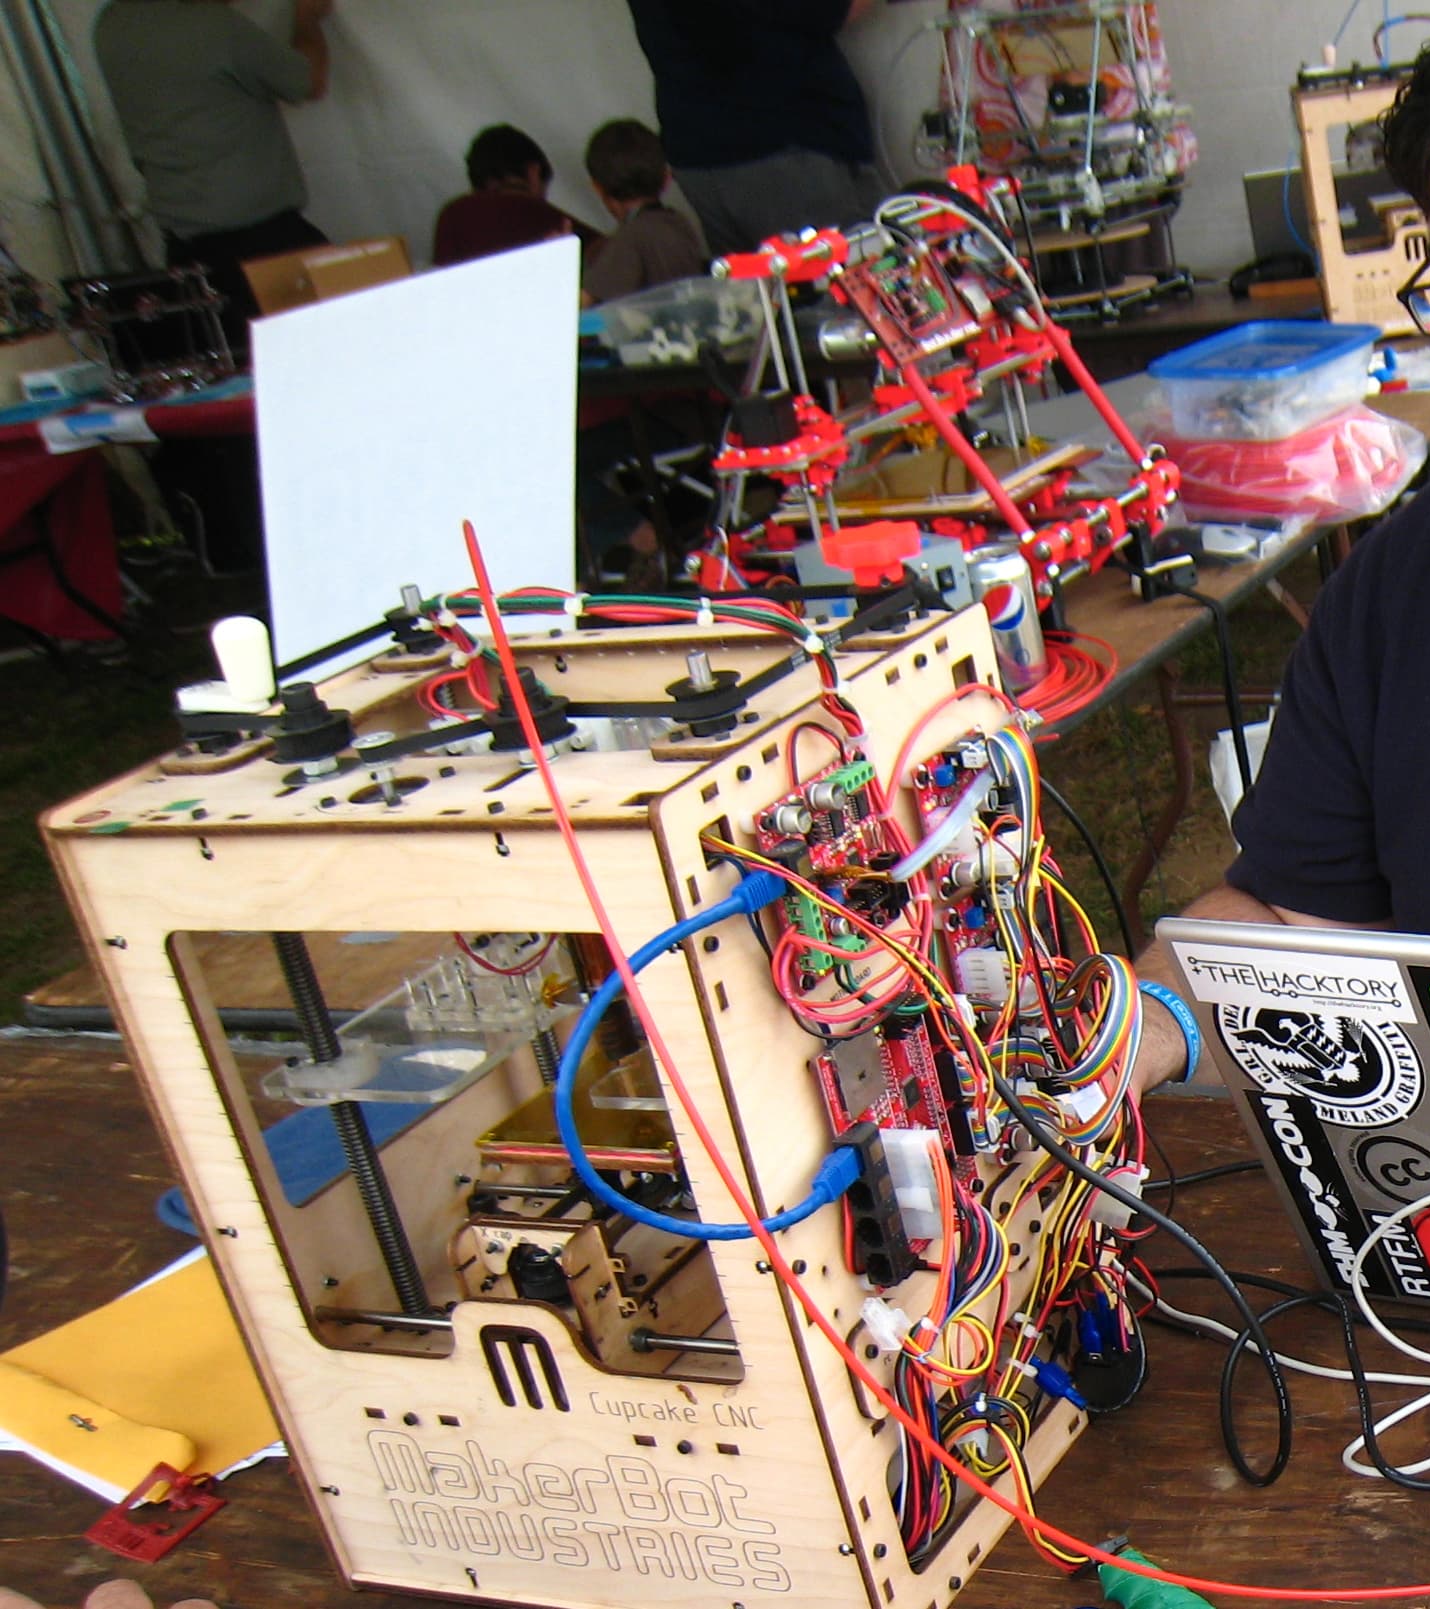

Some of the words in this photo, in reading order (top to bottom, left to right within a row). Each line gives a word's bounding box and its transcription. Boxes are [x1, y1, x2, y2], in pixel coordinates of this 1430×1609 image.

[1206, 965, 1253, 987] THE
[1258, 967, 1399, 999] HACKTORY
[1377, 1020, 1417, 1106] GRAFFITI
[589, 1391, 697, 1425] Cupcake
[712, 1402, 766, 1431] CNC
[366, 1428, 777, 1535] MakerBot
[389, 1498, 792, 1593] INDUSTRIES
